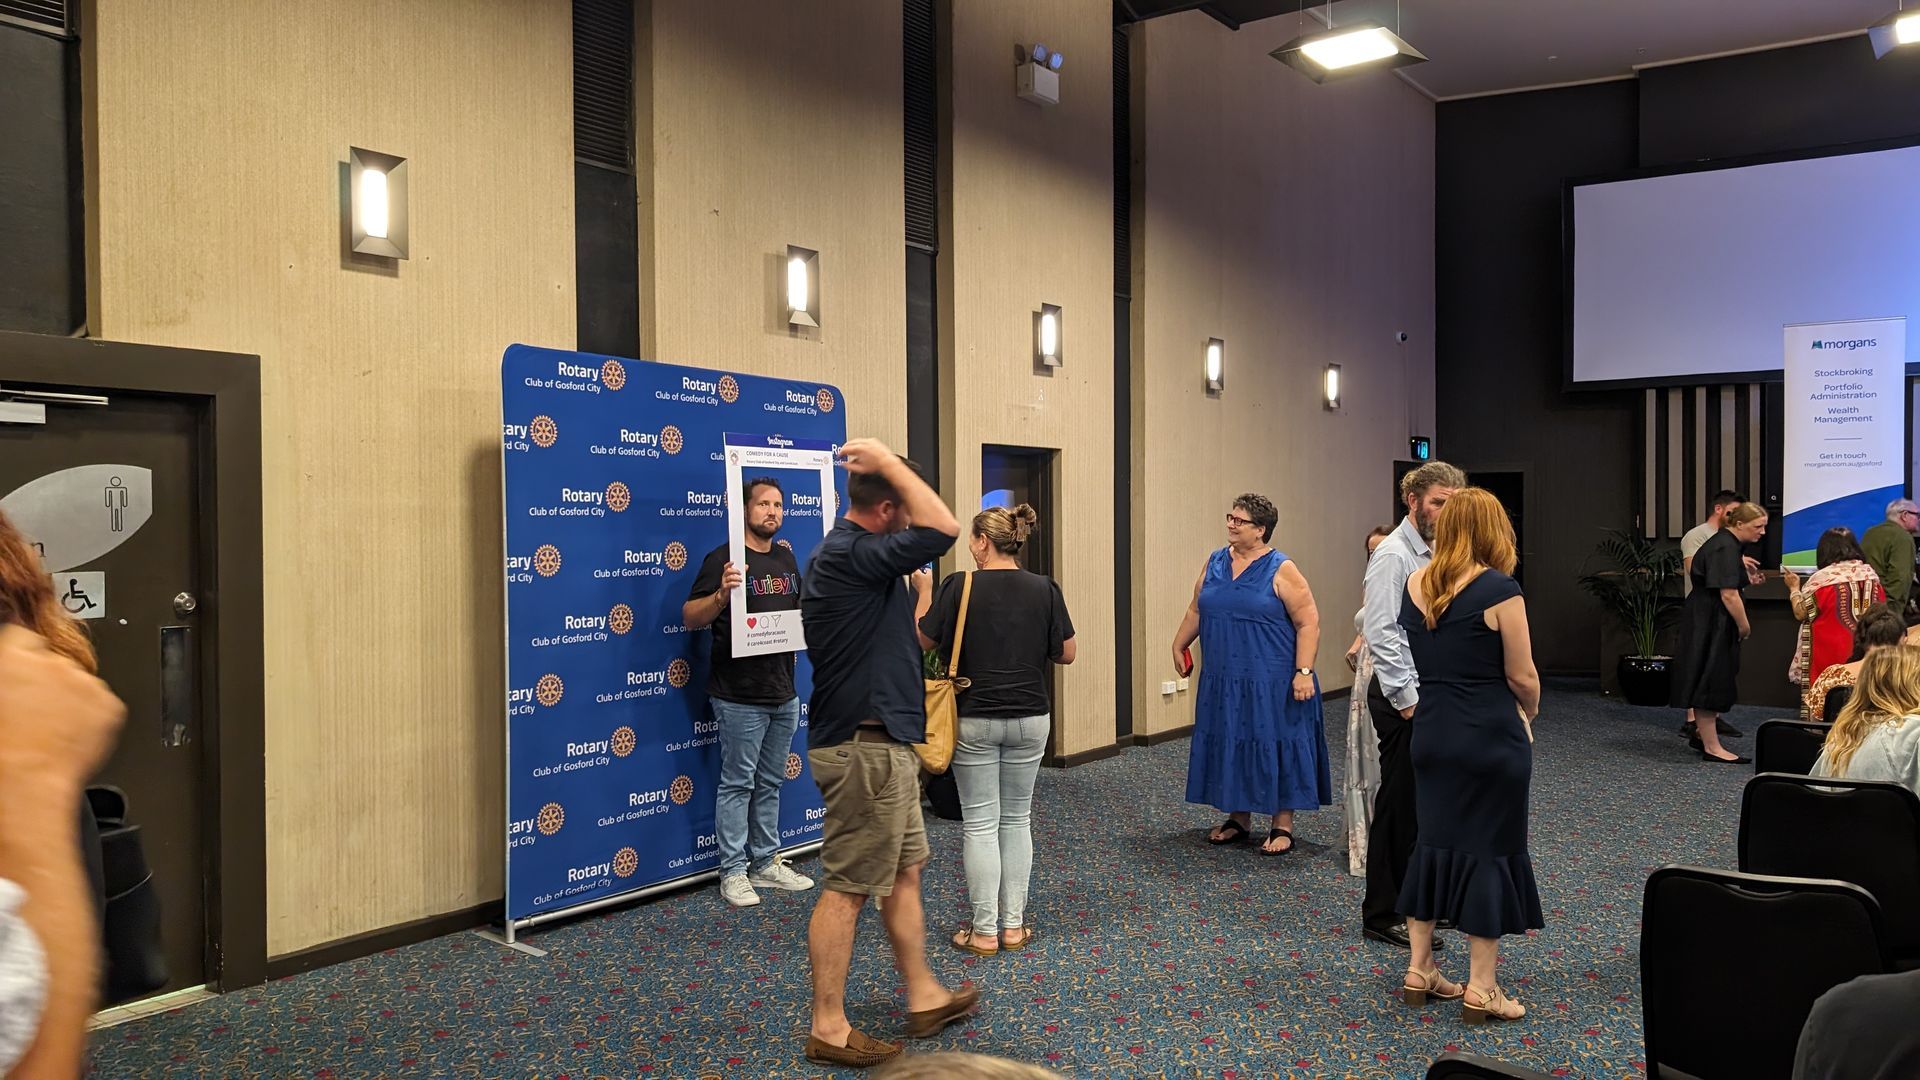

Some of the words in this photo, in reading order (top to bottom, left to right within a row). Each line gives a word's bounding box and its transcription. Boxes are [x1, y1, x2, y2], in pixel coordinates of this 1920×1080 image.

[1824, 338, 1877, 350] morgans
[558, 362, 599, 381] Rotary
[1814, 367, 1874, 377] Stockbroking
[525, 378, 542, 387] Club
[544, 379, 553, 388] of
[555, 380, 584, 391] Gosford
[586, 384, 601, 394] City
[683, 377, 716, 395] Rotary
[1824, 382, 1863, 391] Portfolio
[655, 391, 671, 400] Club
[680, 393, 705, 403] Gosford
[706, 396, 718, 406] City
[786, 390, 815, 406] Rotary
[1810, 391, 1877, 400] Administration
[764, 403, 777, 411] Club
[777, 404, 784, 412] of
[784, 405, 806, 414] Gosford
[807, 407, 817, 416] City
[1827, 406, 1859, 414] Wealth
[1814, 415, 1873, 424] Management
[504, 425, 528, 439] ary
[621, 429, 658, 447] Rotary
[514, 441, 530, 452] City
[767, 436, 793, 449] Instagram
[590, 445, 607, 454] Club
[608, 446, 616, 455] of
[618, 446, 645, 457] Gosford
[646, 448, 660, 459] City
[711, 452, 724, 461] Club
[562, 488, 603, 505] Rotary
[687, 491, 722, 507] Rotary
[792, 493, 821, 508] Rotary
[529, 507, 547, 516] Club
[548, 507, 557, 516] of
[559, 507, 589, 517] Gosford
[590, 507, 605, 518] City
[660, 508, 675, 516] Club
[676, 508, 684, 516] of
[685, 508, 710, 516] Gosford
[711, 508, 723, 518] City
[783, 508, 789, 516] of
[790, 508, 811, 517] Gosford
[812, 508, 823, 518] City
[507, 556, 532, 570] ary
[625, 550, 662, 565] Rotary
[517, 573, 533, 584] City
[594, 569, 611, 578] Club
[612, 568, 620, 577] of
[621, 567, 649, 577] Gosford
[650, 567, 664, 577] City
[565, 616, 606, 629] Rotary
[663, 625, 678, 634] Club
[531, 637, 549, 647] Club
[551, 635, 560, 645] of
[561, 632, 592, 645] Gosford
[593, 631, 608, 642] City
[627, 671, 665, 685] Rotary
[509, 688, 534, 702] ary
[596, 693, 613, 703] Club
[614, 691, 623, 700] of
[624, 688, 651, 700] Gosford
[653, 686, 667, 697] City
[519, 705, 536, 715] City
[694, 721, 719, 734] Rota
[567, 740, 608, 757] Rotary
[666, 742, 681, 752] Club
[682, 740, 690, 749] of
[691, 735, 717, 747] Gosford
[533, 766, 551, 777] Club
[553, 764, 562, 774] of
[563, 758, 593, 772] Gosford
[595, 756, 610, 768] City
[629, 789, 668, 806] Rotary
[597, 816, 615, 827] Club
[616, 813, 624, 823] of
[626, 807, 655, 821] Gosford
[656, 803, 670, 815] City
[806, 807, 827, 820] Rota
[509, 818, 535, 834] ary
[782, 829, 795, 838] Club
[796, 826, 803, 835] of
[520, 836, 536, 845] City
[697, 834, 716, 848] Rot
[668, 858, 684, 868] Club
[686, 855, 693, 864] of
[694, 848, 720, 861] Gosford
[568, 862, 610, 883] Rotary
[533, 893, 552, 905] Club
[554, 890, 564, 899] of
[565, 882, 596, 896] Gosford
[597, 878, 613, 889] City
